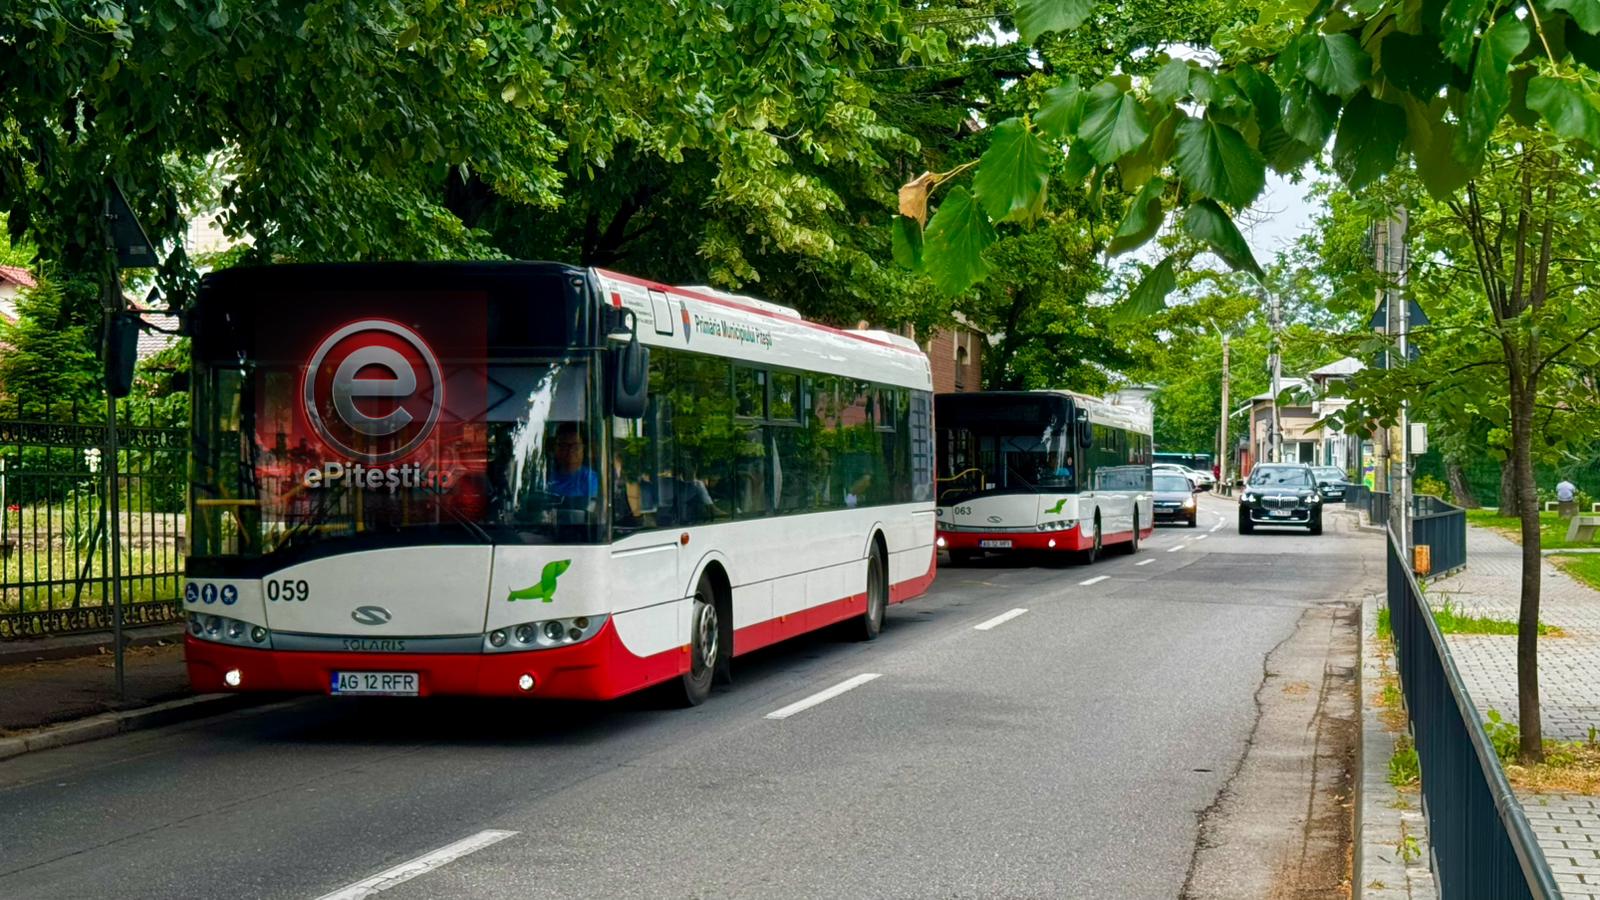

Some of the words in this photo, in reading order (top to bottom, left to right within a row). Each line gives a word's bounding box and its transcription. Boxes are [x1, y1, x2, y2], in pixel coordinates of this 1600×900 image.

[954, 506, 972, 515] 063
[267, 579, 309, 602] 059
[342, 639, 406, 651] SOLARIS
[339, 675, 359, 690] AG
[364, 675, 378, 690] 12
[381, 675, 414, 690] RFR
